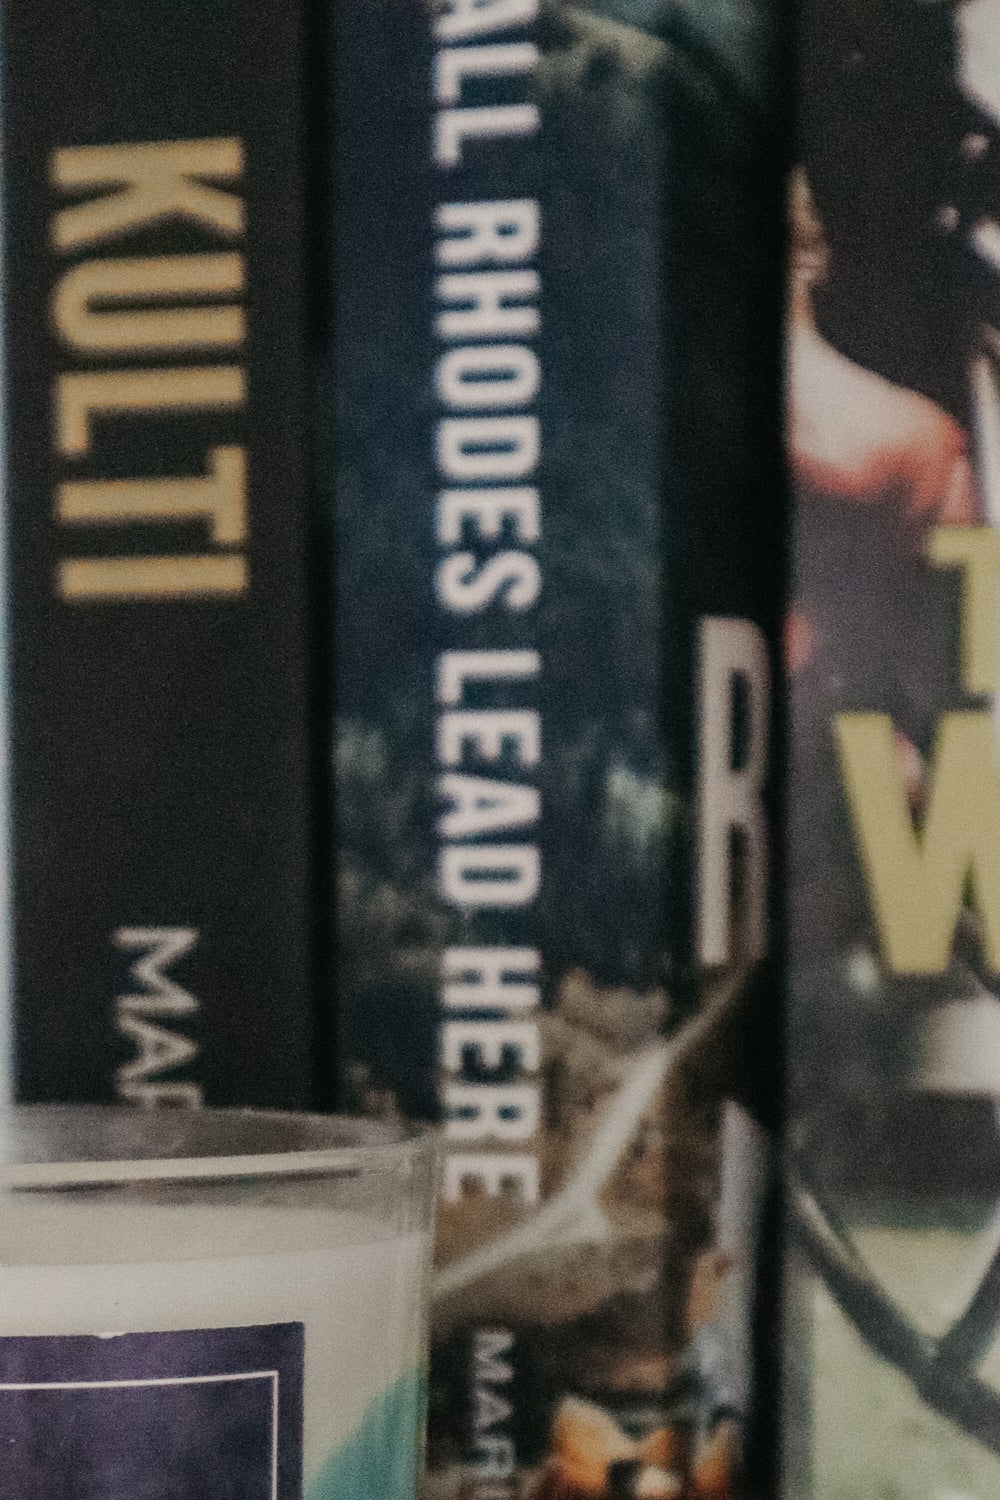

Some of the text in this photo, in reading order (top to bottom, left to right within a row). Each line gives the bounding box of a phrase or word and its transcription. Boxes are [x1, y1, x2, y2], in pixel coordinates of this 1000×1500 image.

[52, 136, 247, 602] KULTI
[434, 199, 541, 612] RHODES
[438, 649, 541, 907] LEAD
[442, 946, 541, 1202] HERE
